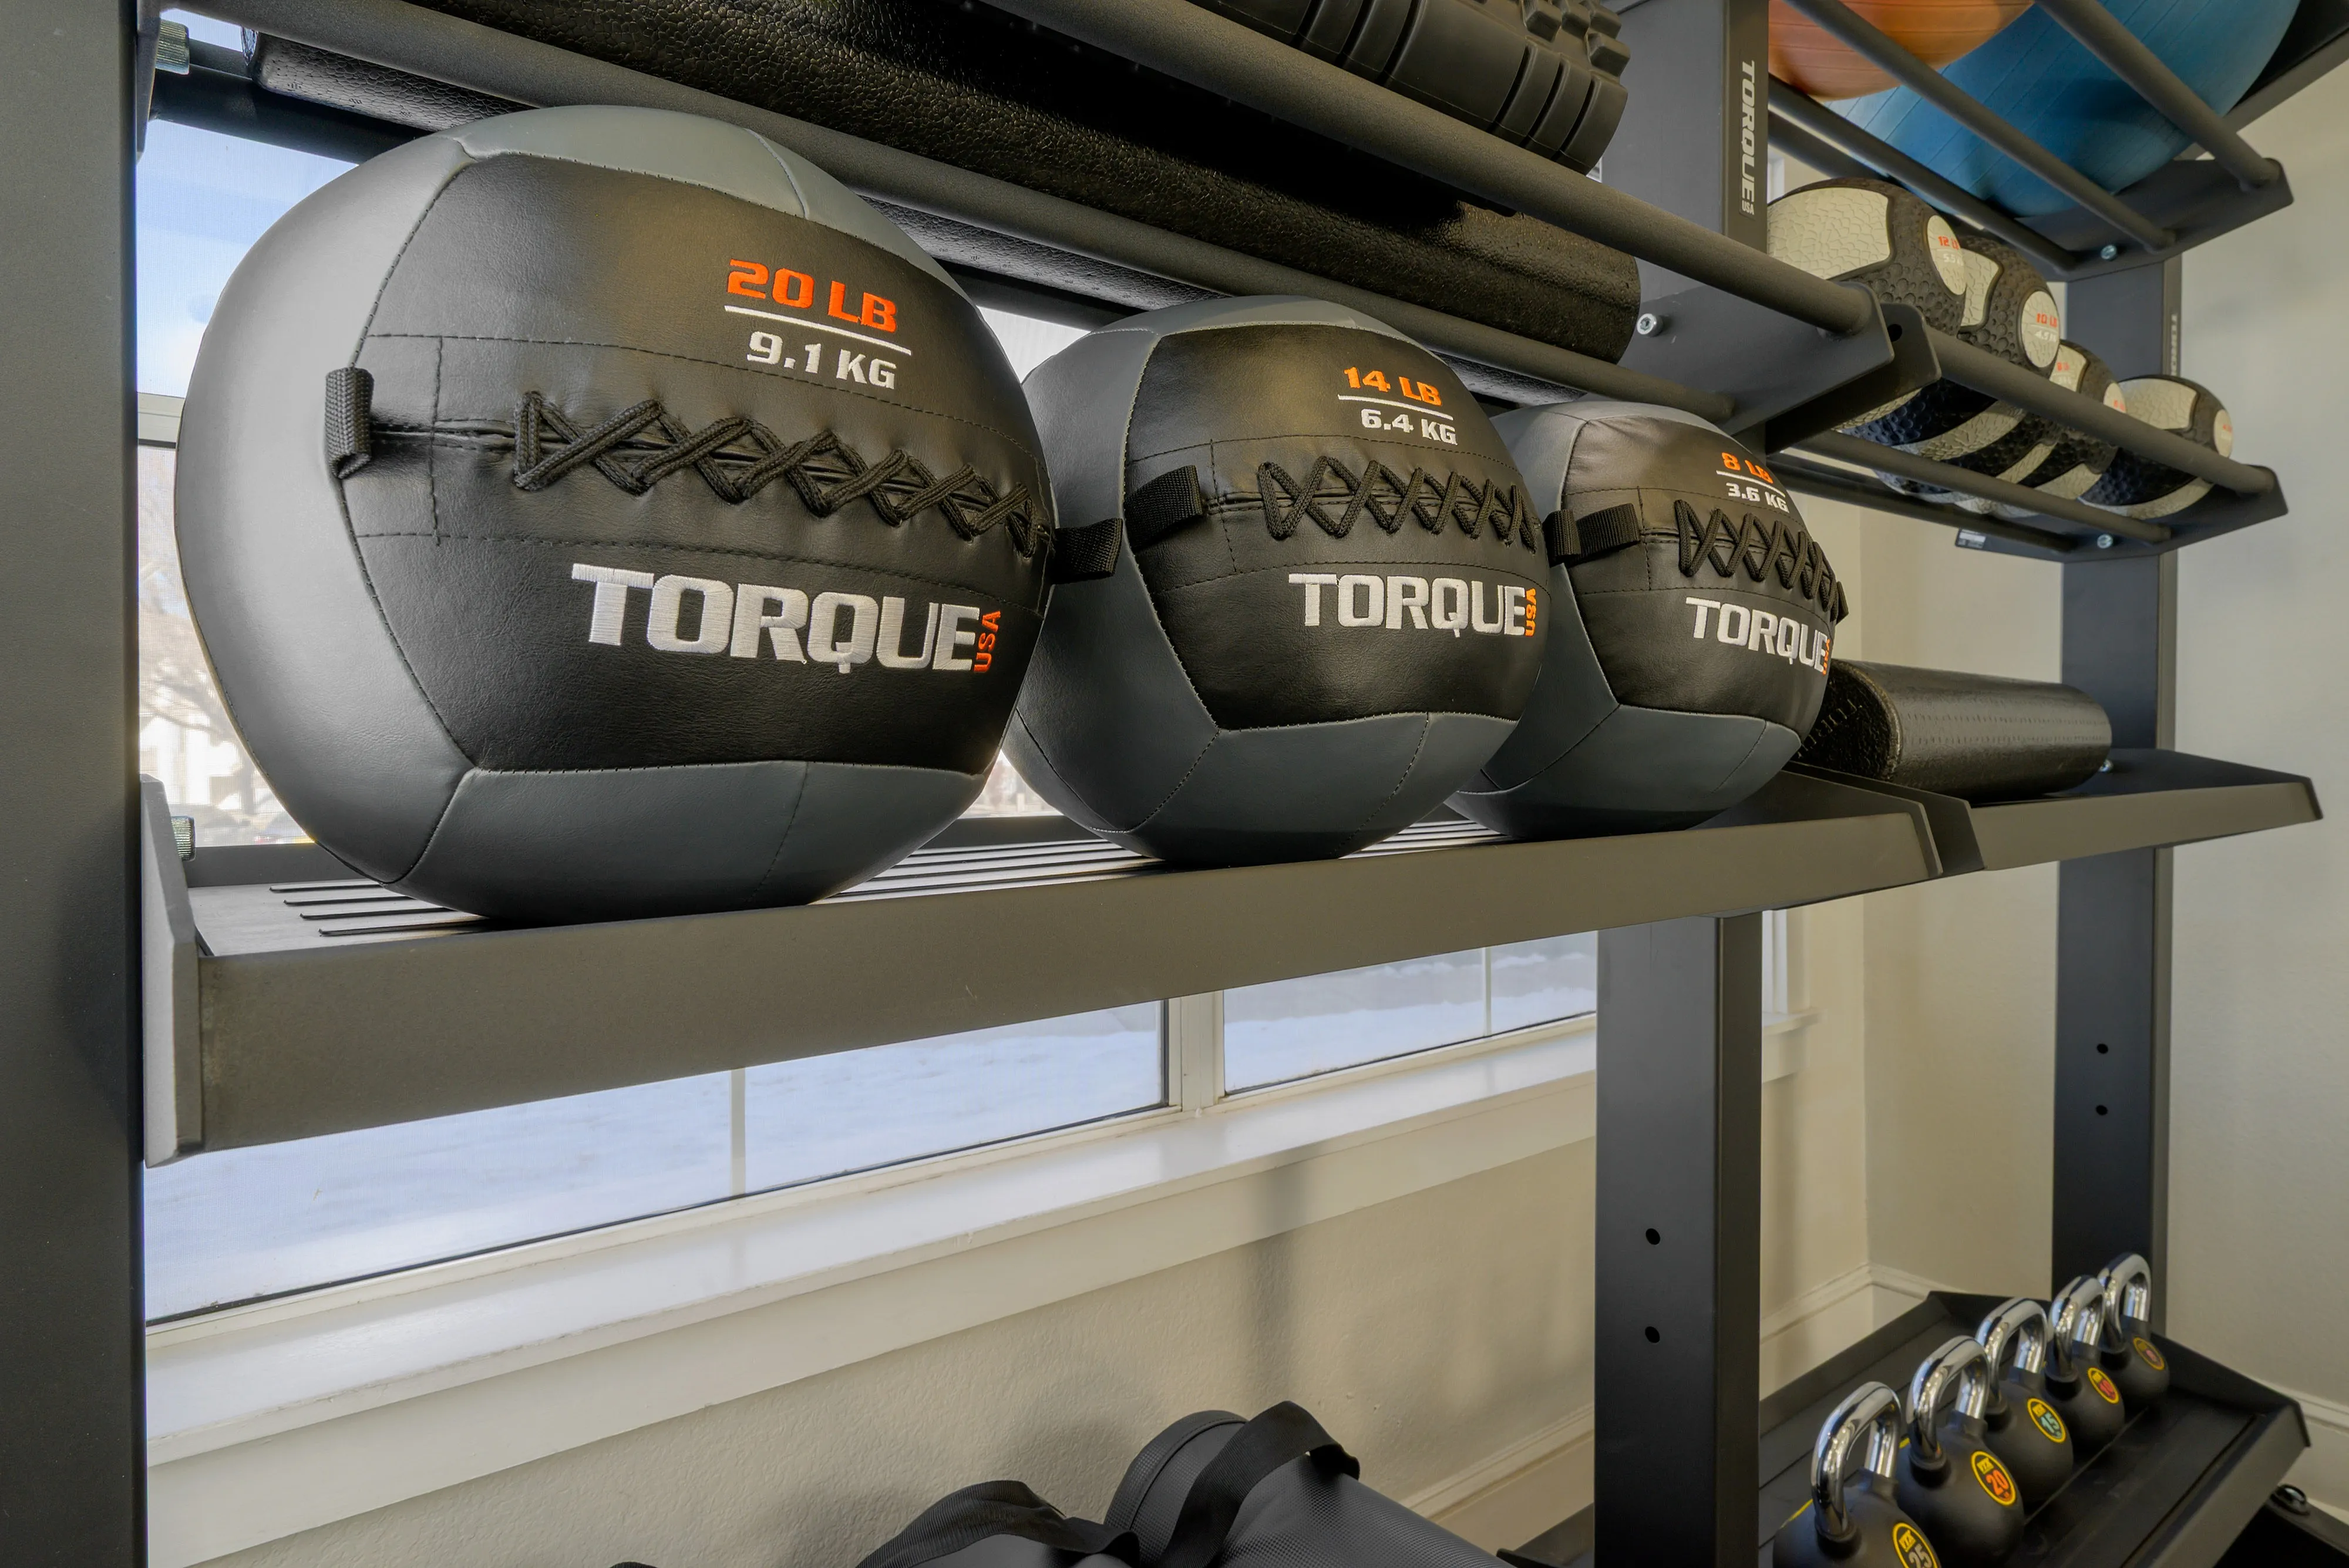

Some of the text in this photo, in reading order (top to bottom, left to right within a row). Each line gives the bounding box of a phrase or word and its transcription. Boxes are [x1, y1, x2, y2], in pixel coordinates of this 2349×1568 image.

[1741, 60, 1755, 215] TORQUE USA
[1938, 235, 1950, 247] 12
[727, 259, 897, 333] 20 LB
[2036, 312, 2047, 324] 10
[746, 331, 897, 390] 9.1 KG
[1344, 366, 1442, 406] 14 LB
[1361, 408, 1458, 446] 6.4 KG
[1721, 452, 1773, 484] 8 LB
[1725, 482, 1790, 514] 3.6 KG
[571, 563, 1001, 674] TORQUE USA
[1288, 573, 1537, 638] TORQUE USA
[1685, 597, 1828, 673] TORQUE
[1985, 1469, 2009, 1496] 20
[1908, 1543, 1933, 1568] 25
